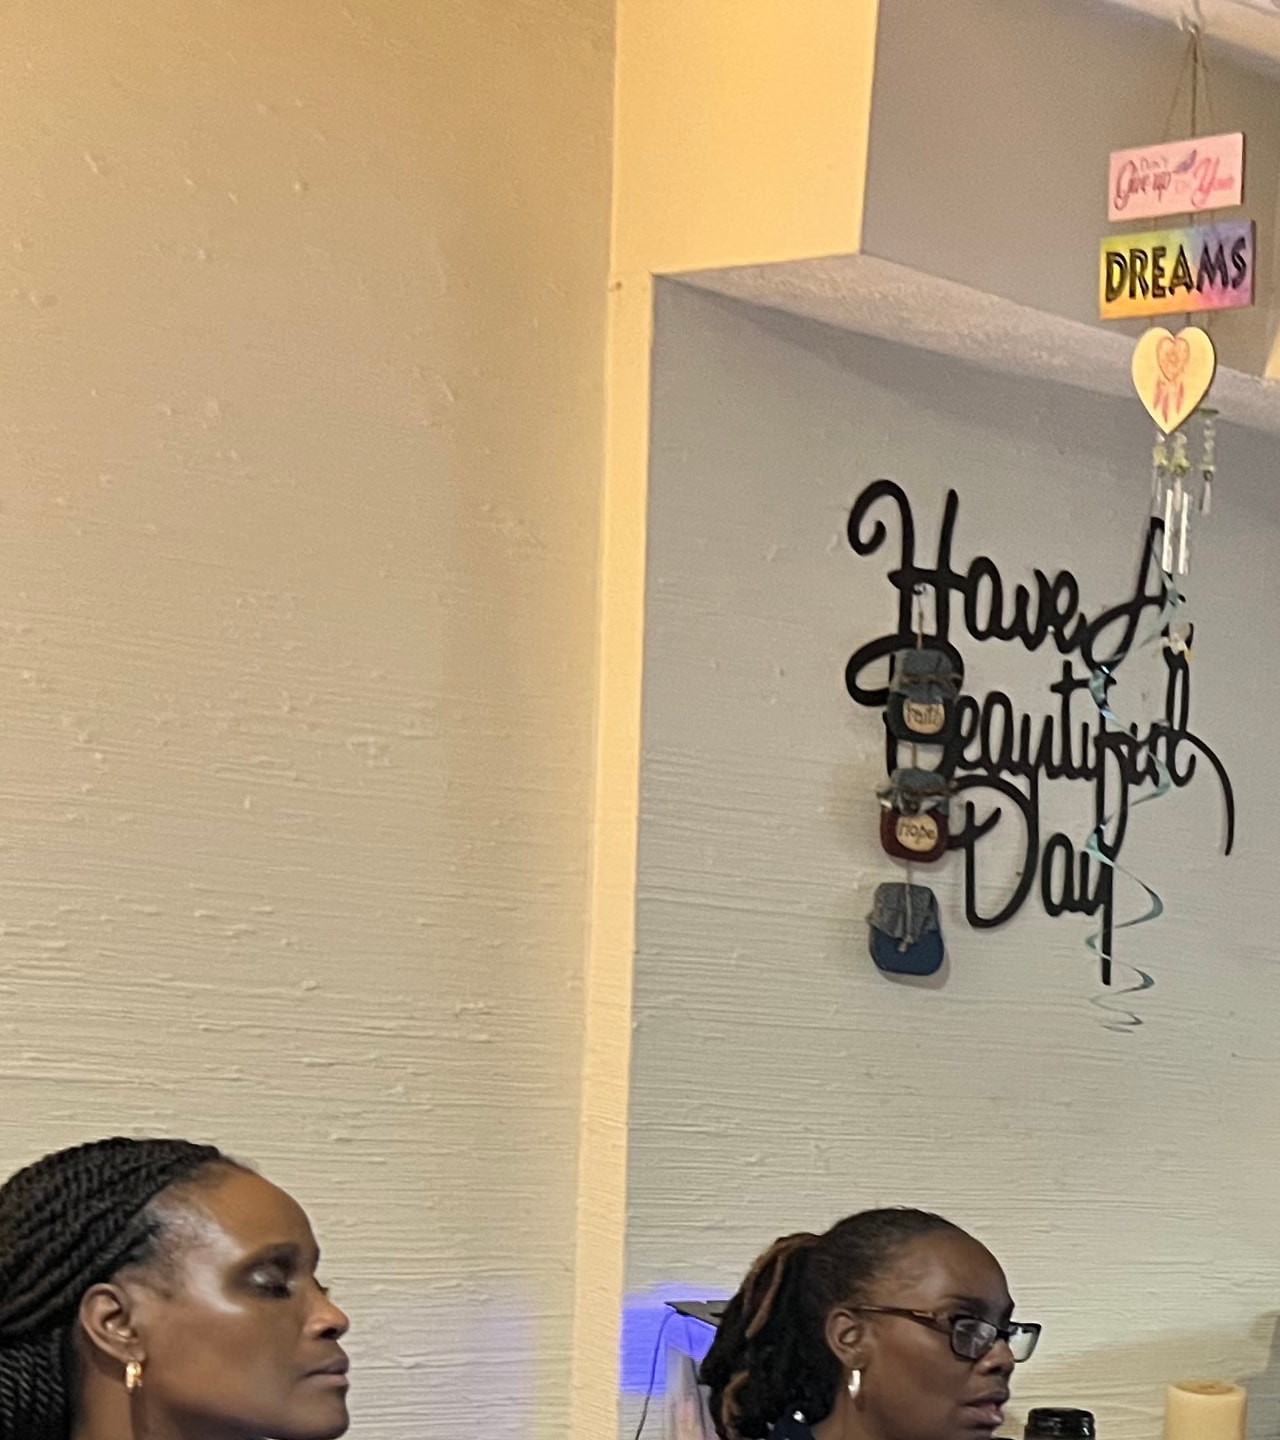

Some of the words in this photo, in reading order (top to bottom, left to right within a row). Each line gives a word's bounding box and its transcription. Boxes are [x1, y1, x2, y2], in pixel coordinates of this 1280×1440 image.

[1105, 236, 1248, 304] DREAMS
[847, 479, 1084, 655] Have
[946, 774, 1130, 986] Day
